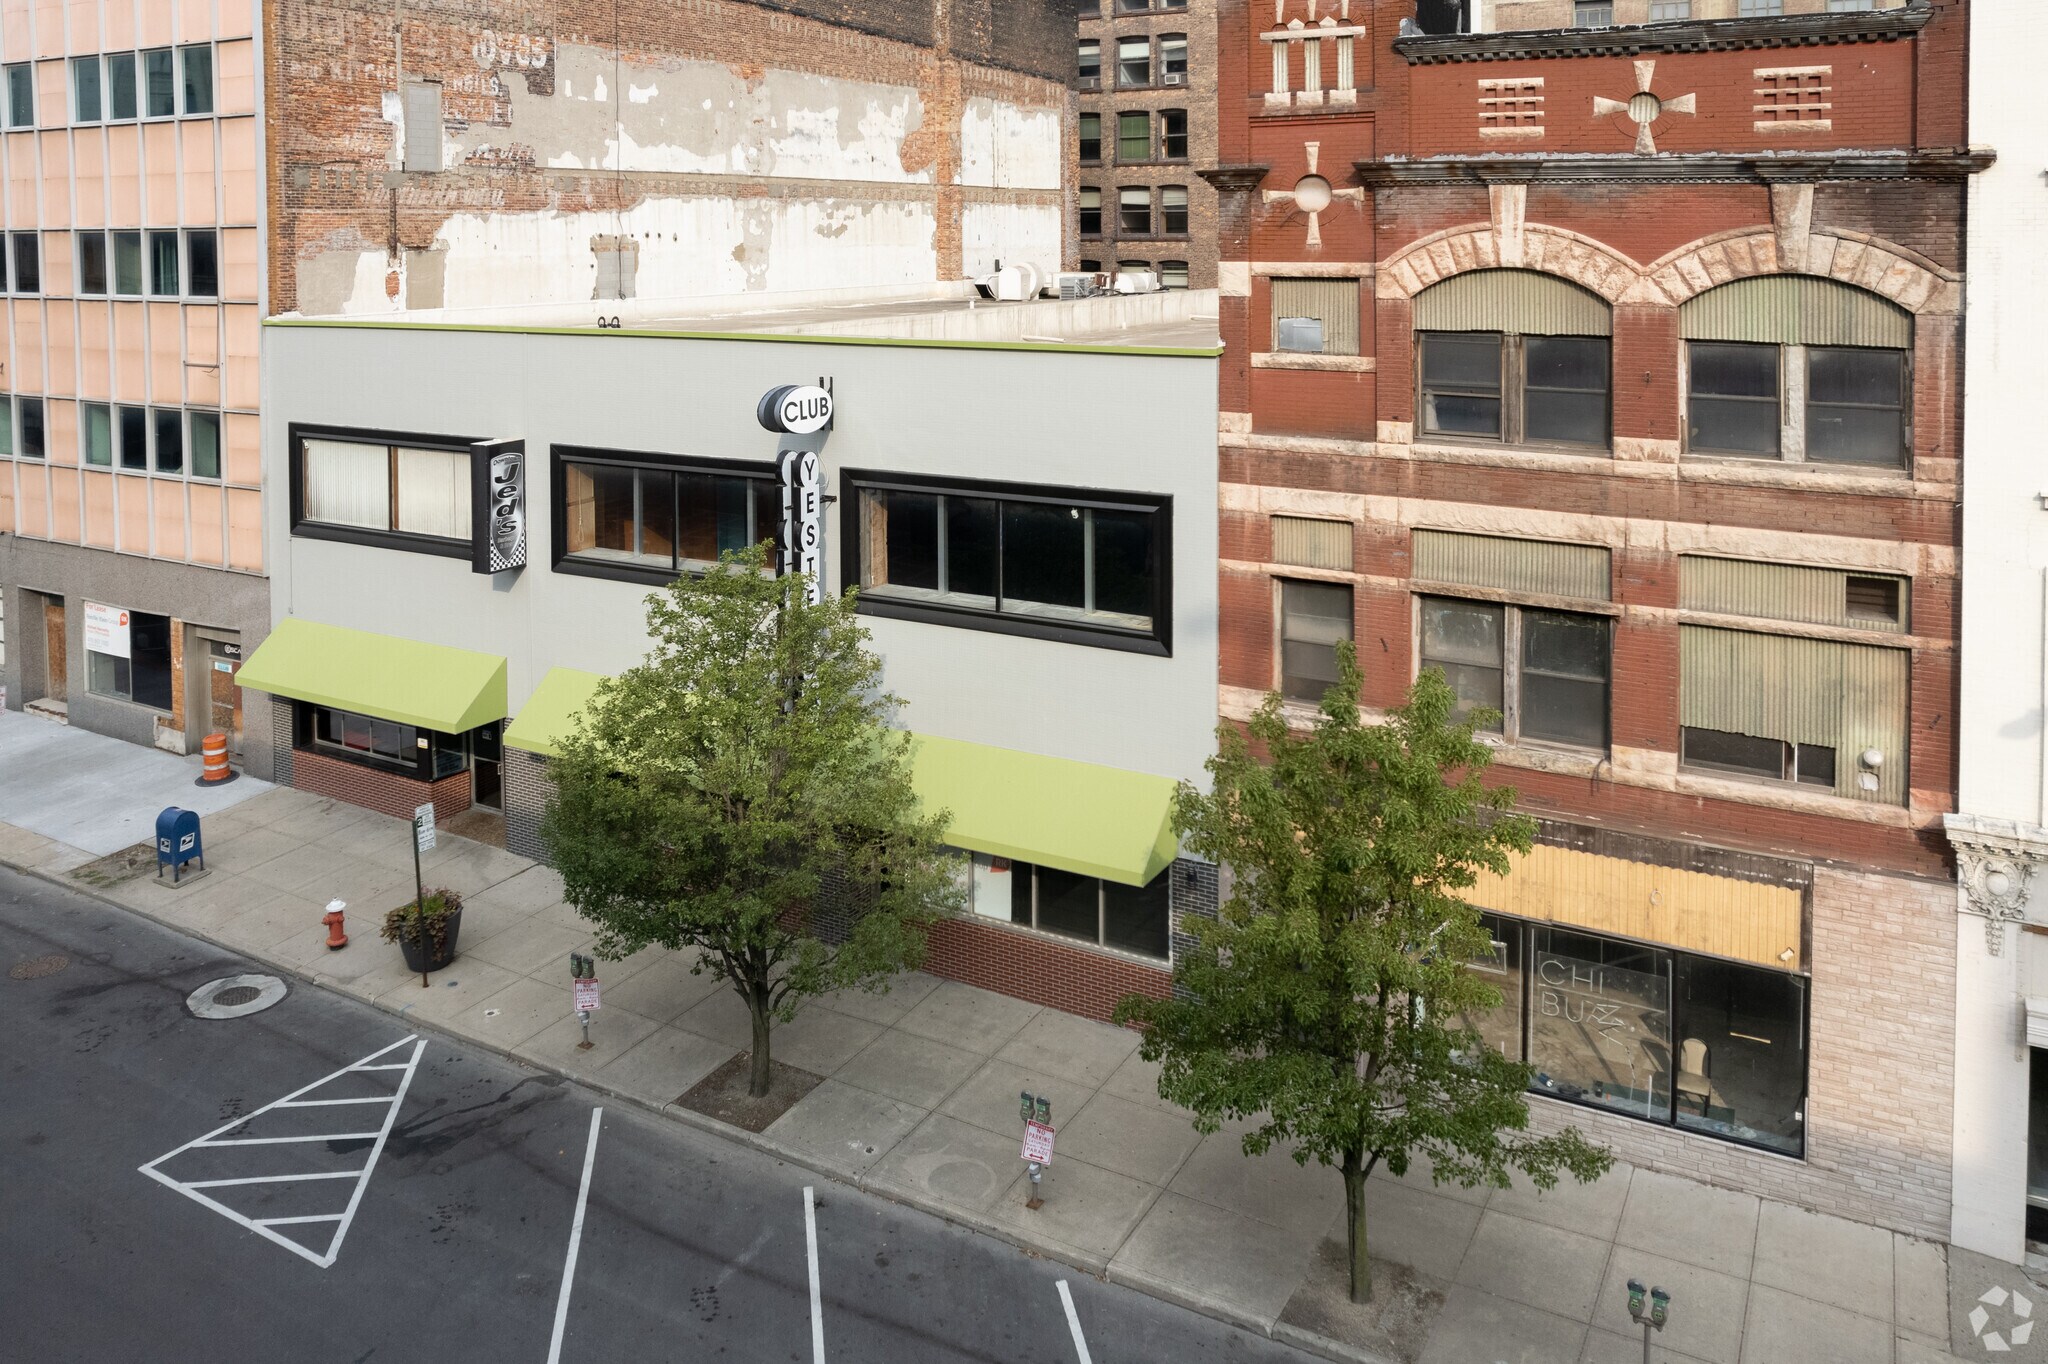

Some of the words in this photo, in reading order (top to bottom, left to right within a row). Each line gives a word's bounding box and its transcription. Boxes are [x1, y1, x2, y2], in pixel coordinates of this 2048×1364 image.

[784, 397, 829, 422] CLUB
[1036, 1128, 1046, 1136] NO
[1028, 1132, 1051, 1144] PARKING
[1026, 1147, 1049, 1156] PARADE
